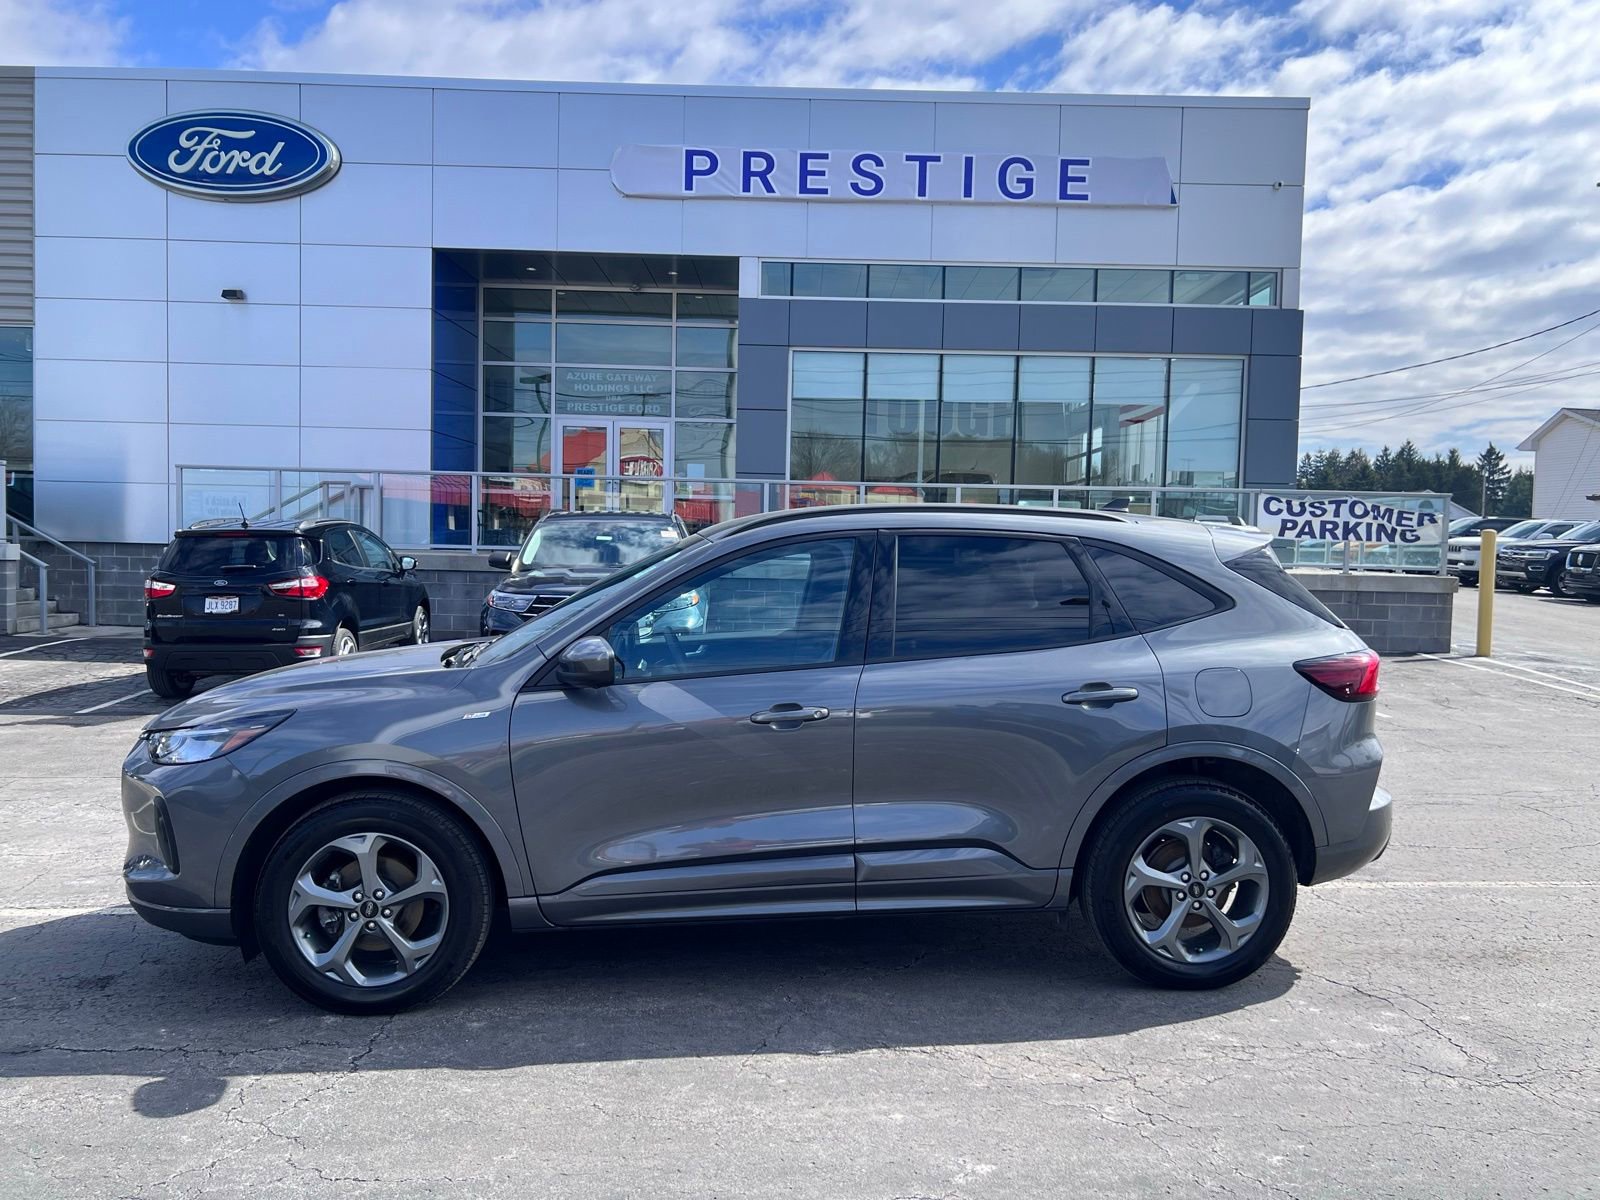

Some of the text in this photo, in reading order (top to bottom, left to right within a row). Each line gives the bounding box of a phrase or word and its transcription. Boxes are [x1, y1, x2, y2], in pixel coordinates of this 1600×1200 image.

[168, 127, 285, 175] Ford
[684, 149, 1091, 201] PRESTIGE
[566, 372, 657, 382] AZURE GATEWAY
[574, 383, 654, 393] HOLDINGS LLC
[567, 402, 661, 413] PRESTIGE FORD
[1263, 496, 1438, 528] CUSTOMER
[1278, 518, 1421, 543] PARKING
[207, 600, 237, 610] JLX 9287
